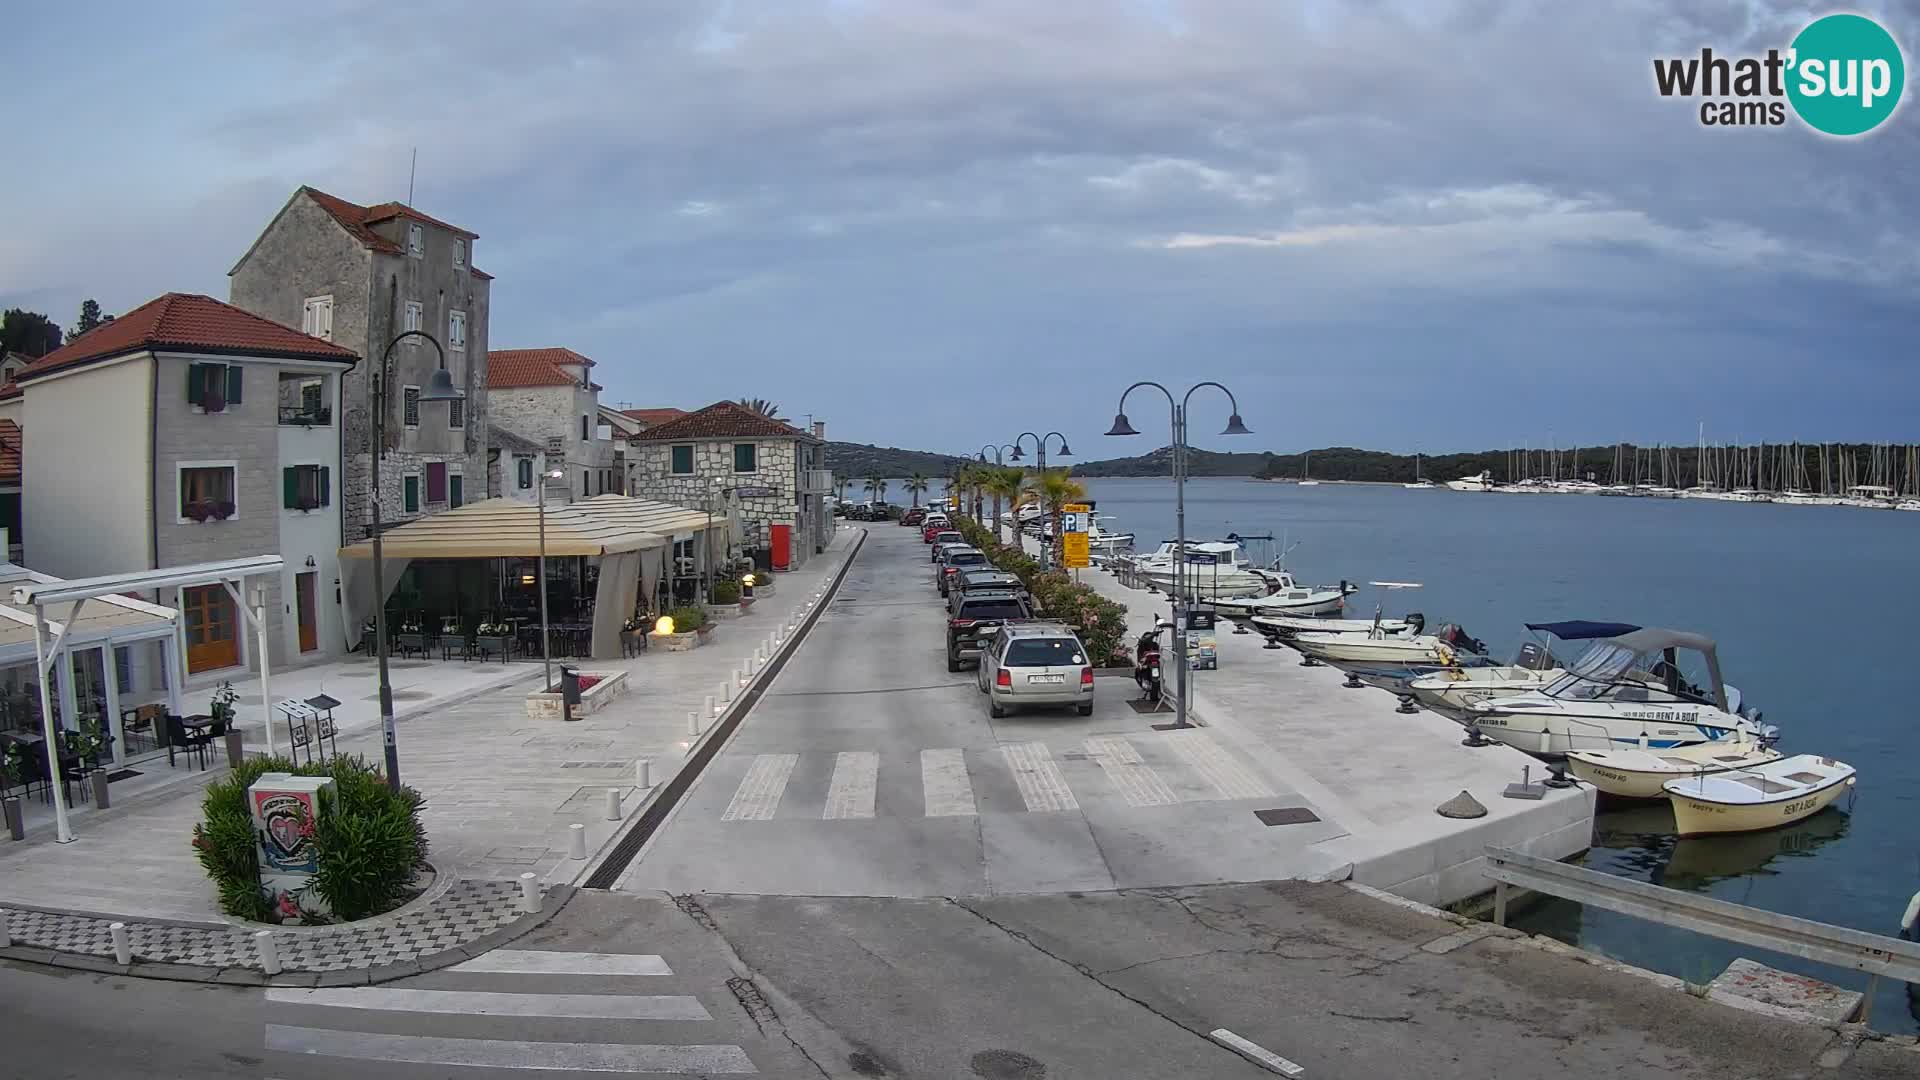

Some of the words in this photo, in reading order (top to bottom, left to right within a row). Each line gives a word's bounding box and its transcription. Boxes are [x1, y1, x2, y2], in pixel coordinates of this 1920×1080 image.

[1656, 711, 1674, 720] RENT
[1675, 711, 1681, 721] A
[1681, 712, 1699, 722] BOAT
[1783, 803, 1800, 814] RENT
[1803, 797, 1817, 810] BOAT
